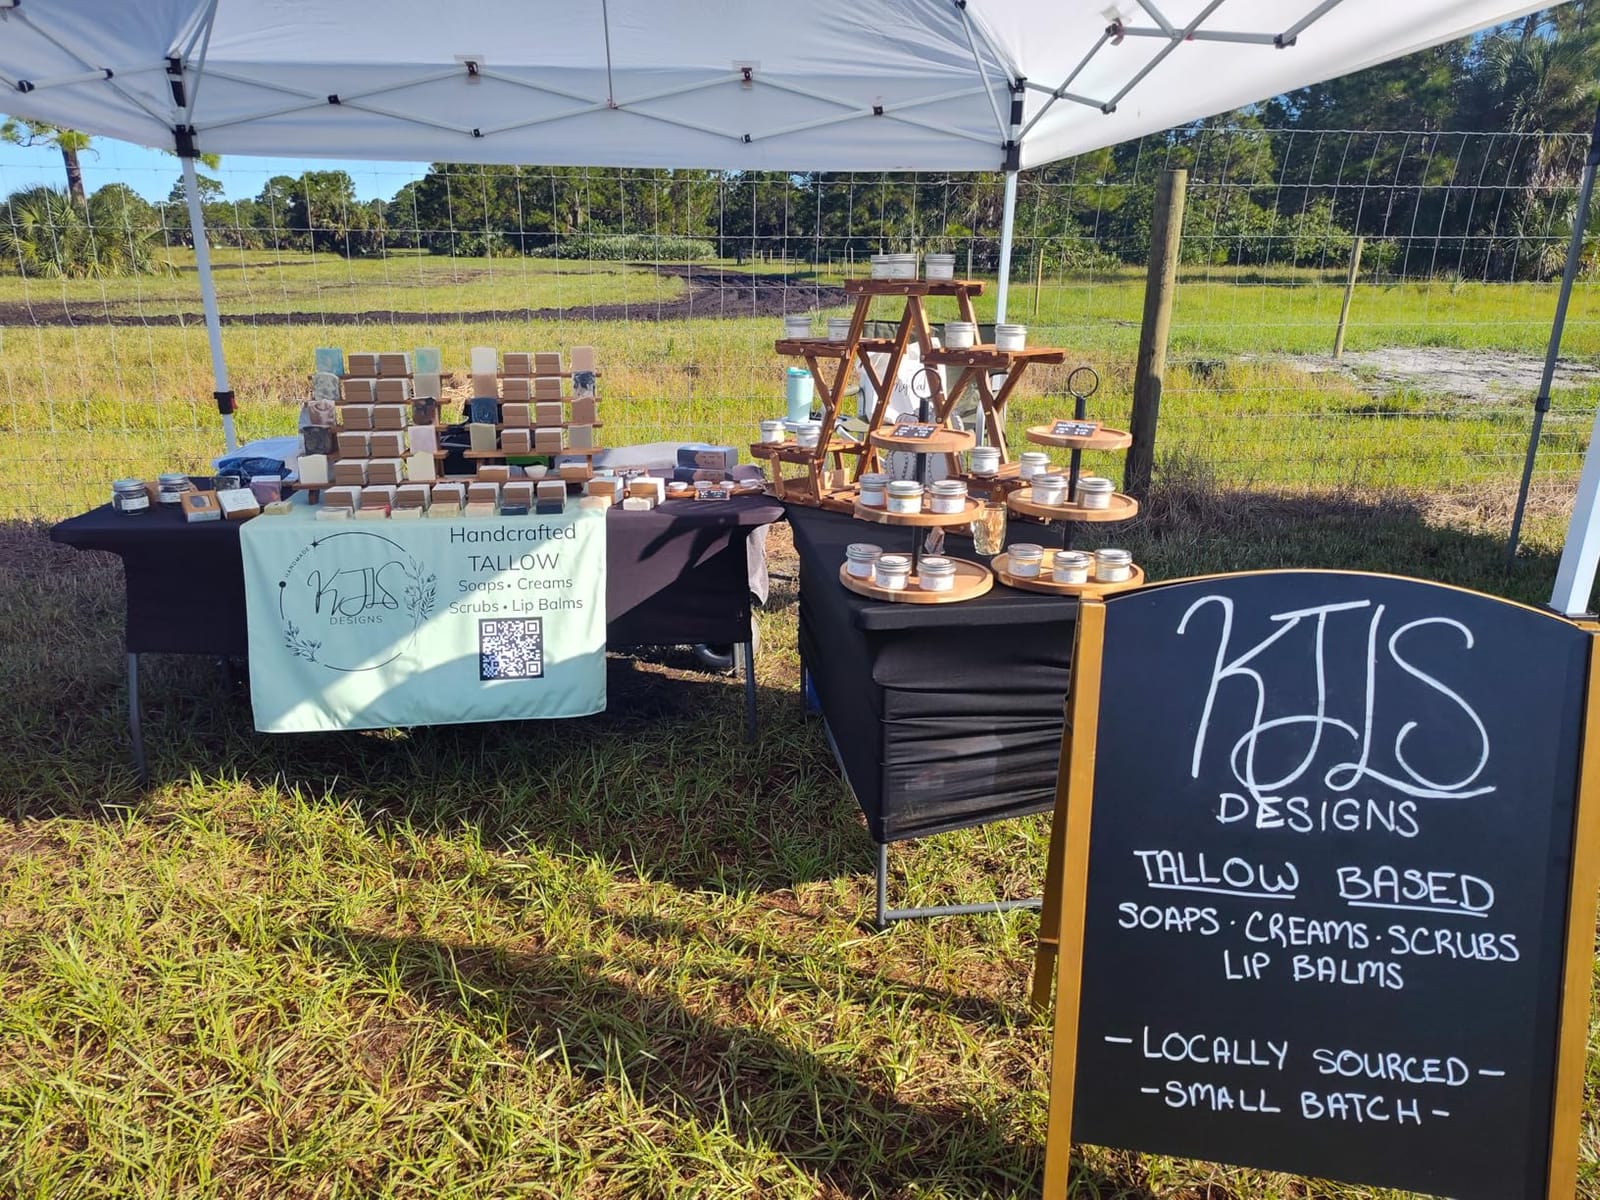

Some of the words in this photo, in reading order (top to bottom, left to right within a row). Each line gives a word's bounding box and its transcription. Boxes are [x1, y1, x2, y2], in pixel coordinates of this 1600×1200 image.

[450, 524, 576, 543] Handcrafted
[468, 553, 560, 572] TALLOW
[459, 579, 504, 593] Soaps
[517, 577, 573, 590] Creams
[449, 601, 498, 615] Scrubs
[512, 600, 535, 614] Lip
[539, 598, 583, 612] Balms
[330, 615, 383, 625] DESIGNS
[1216, 792, 1419, 837] DESIGNS
[1134, 849, 1299, 893] TALLOW
[1338, 866, 1495, 911] BASED
[1118, 902, 1220, 935] SOAPS
[1245, 911, 1369, 949] CREAMS
[1389, 931, 1520, 962] SCRUBS
[1225, 950, 1270, 980] LIP
[1294, 955, 1404, 990] BALMS
